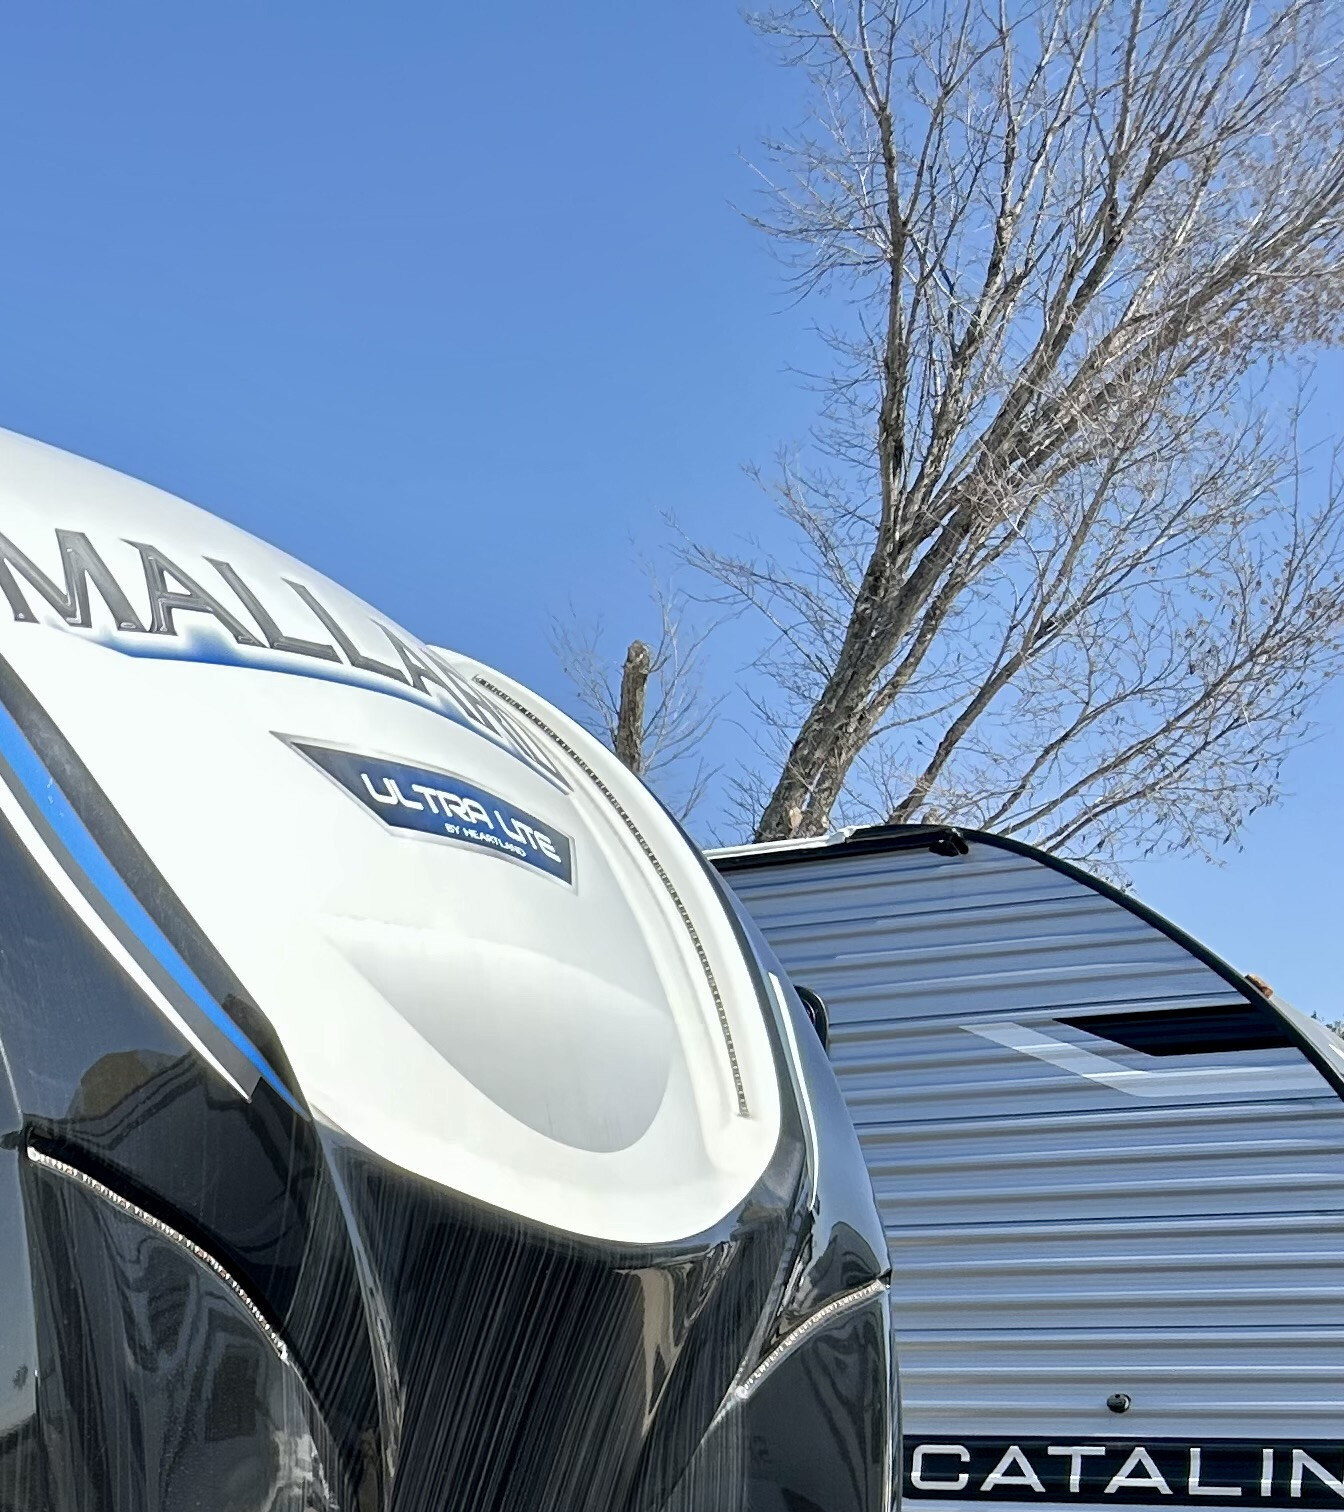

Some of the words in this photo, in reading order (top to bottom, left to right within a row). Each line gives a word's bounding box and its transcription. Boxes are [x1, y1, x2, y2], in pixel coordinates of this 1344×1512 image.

[360, 772, 495, 830] ULTRA
[494, 809, 562, 864] LITE
[444, 822, 461, 836] BY
[462, 827, 527, 859] HEARTLAND
